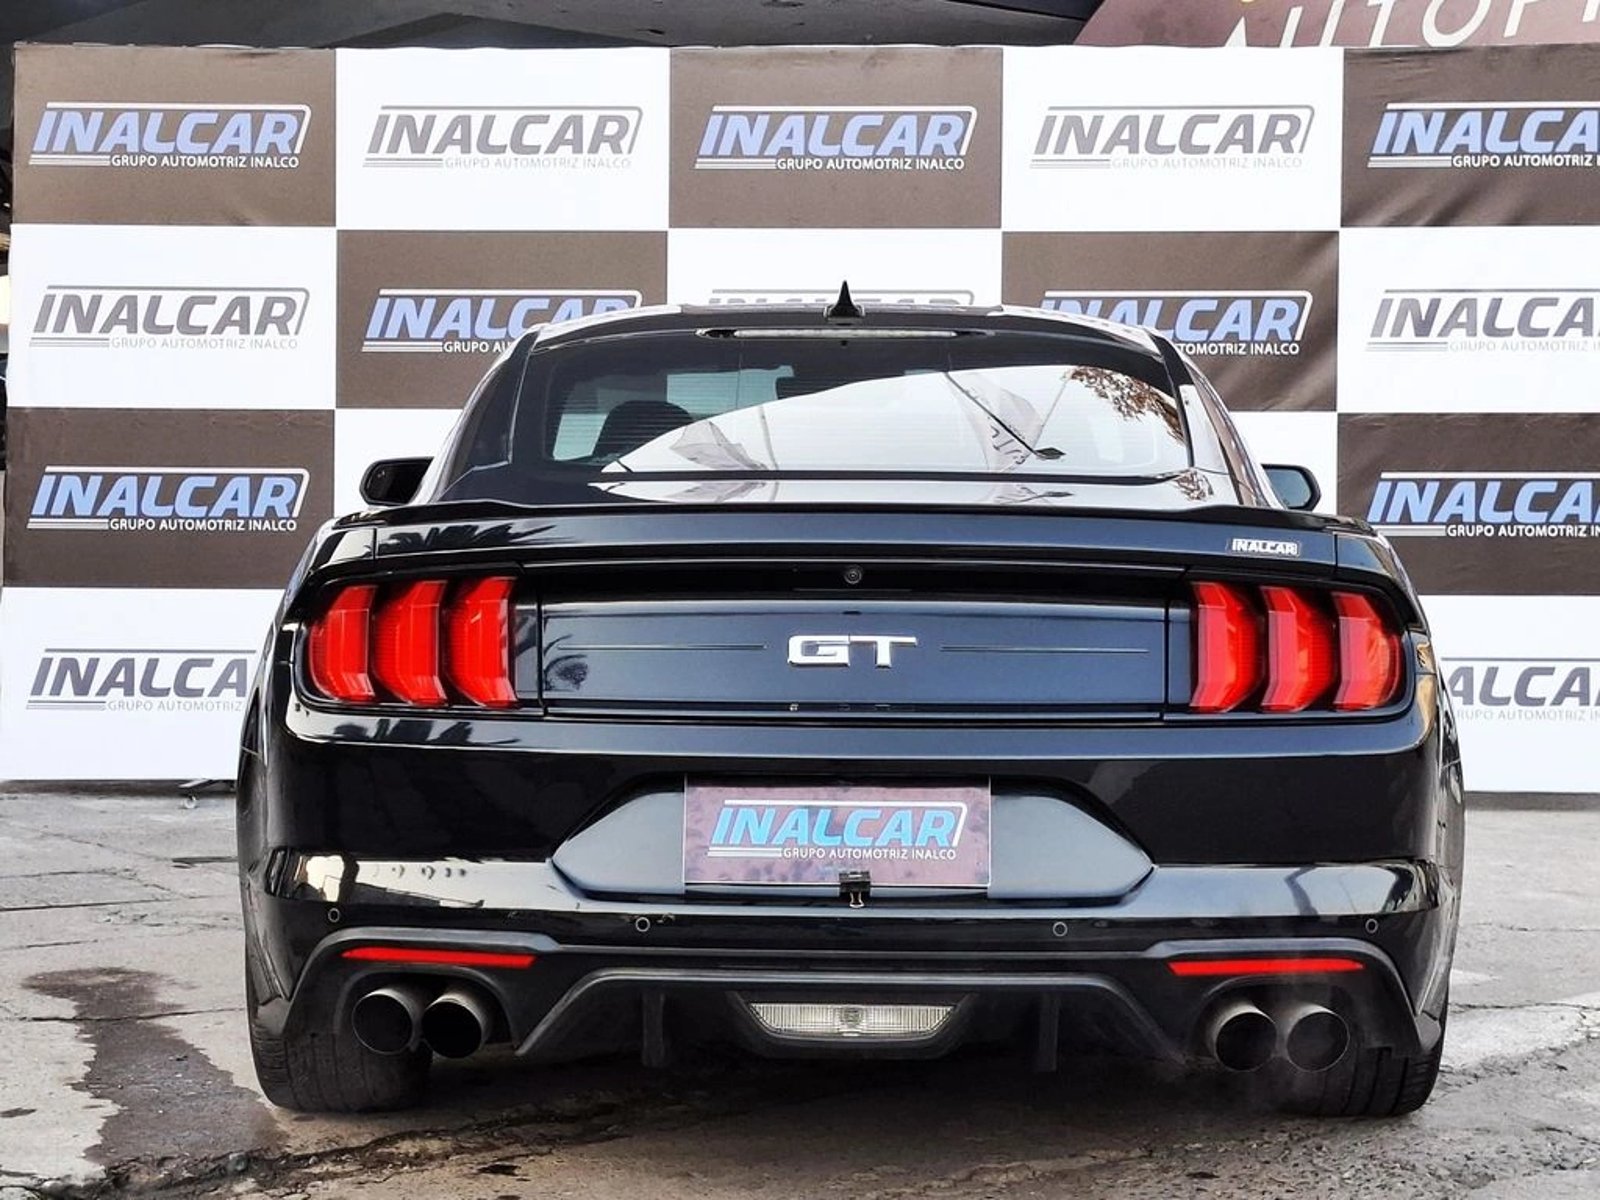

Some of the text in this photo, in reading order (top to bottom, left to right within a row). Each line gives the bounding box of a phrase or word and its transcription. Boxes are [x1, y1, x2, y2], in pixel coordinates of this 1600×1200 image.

[32, 110, 299, 154] INALCAR
[367, 114, 630, 155] INALCAR
[699, 114, 964, 156] INALCAR
[1034, 114, 1302, 154] INALCAR
[1372, 110, 1600, 154] INALCA
[111, 155, 299, 168] GRUPO AUTOMOTRIZ INALCO
[445, 157, 631, 169] GRUPO AUTOMOTRIZ INALCO
[777, 158, 964, 170] GRUPO AUTOMOTRIZ INALCO
[1112, 157, 1302, 169] GRUPO AUTOMOTRIZ INALCO
[1453, 155, 1500, 167] GRUPO
[1504, 154, 1593, 167] AUTOMOTRIZ
[33, 294, 297, 336] INALCAR
[365, 298, 628, 339] INALC
[1370, 298, 1600, 338] INALCA
[111, 337, 298, 349] GRUPO AUTOMOTRIZ INALCO
[444, 341, 489, 353] GRUPO
[1178, 342, 1299, 355] TOMOTRIZ INALCO
[1450, 340, 1497, 351] GRUPO
[1502, 340, 1588, 352] AUTOMOTRIZ
[31, 475, 296, 518] INALCAR
[1367, 480, 1600, 523] INALCA
[110, 518, 297, 531] GRUPO AUTOMOTRIZ INALCO
[1447, 525, 1494, 537] GRUPO
[1498, 525, 1586, 537] AUTOMOTRIZ
[1232, 538, 1296, 555] INALCAR
[787, 635, 917, 668] GT
[30, 657, 248, 697] INALCA
[108, 702, 242, 712] GRUPO AUTOMOTRIZ
[1456, 709, 1493, 720] RUPO
[1498, 709, 1585, 721] AUTOMOTRIZ
[711, 807, 956, 847] INALCAR
[784, 848, 956, 860] GRUPO AUTOMOTRIZ INALCO
